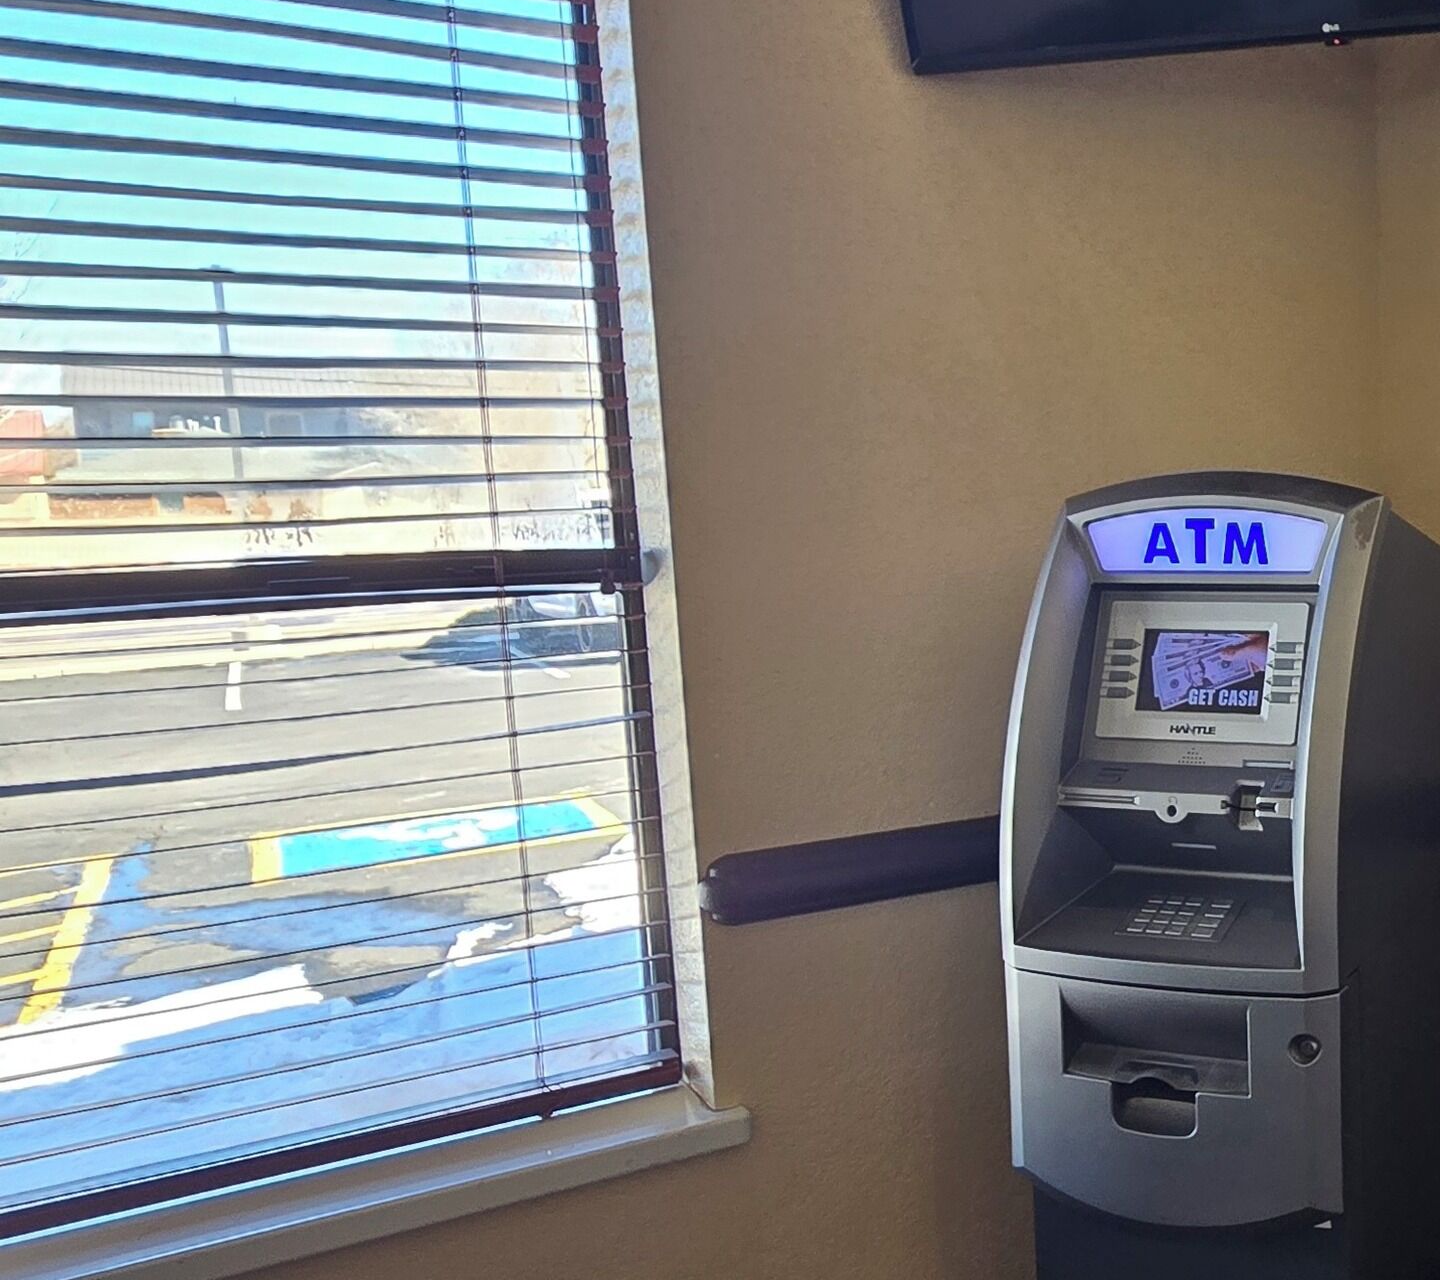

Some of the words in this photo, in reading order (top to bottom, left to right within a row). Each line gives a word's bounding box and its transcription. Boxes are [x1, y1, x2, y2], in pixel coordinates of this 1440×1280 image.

[1143, 517, 1269, 565] ATM
[1188, 689, 1215, 706] GET
[1218, 689, 1259, 707] CASH
[1169, 724, 1216, 735] HANTLE
